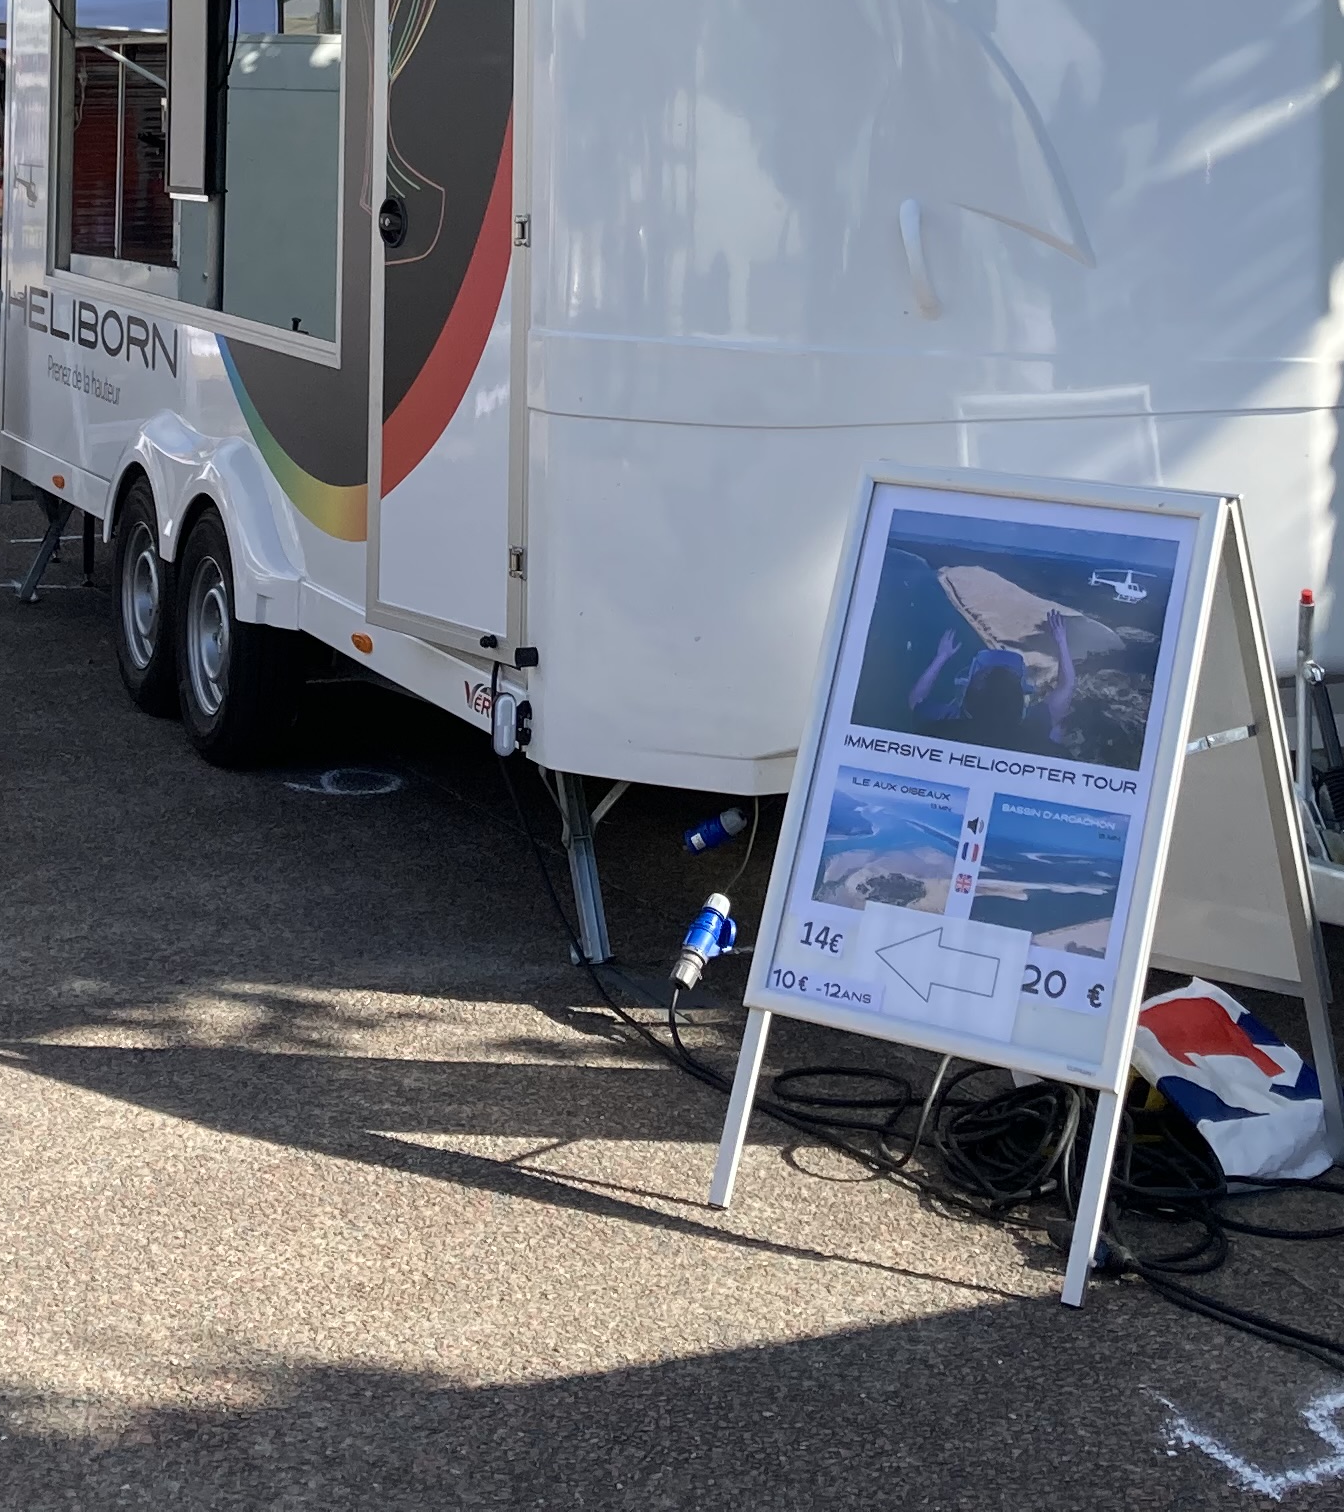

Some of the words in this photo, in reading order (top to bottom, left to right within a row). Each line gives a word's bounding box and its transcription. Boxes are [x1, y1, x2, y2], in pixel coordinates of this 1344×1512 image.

[8, 279, 178, 379] HELIBORN
[48, 354, 71, 387] Prenez
[72, 364, 82, 391] de
[83, 364, 90, 394] la
[91, 369, 121, 406] hauteur
[843, 734, 944, 763] IMMERSIVE
[948, 752, 1076, 786] HELICOPTER
[1082, 774, 1138, 795] TOUR
[852, 776, 871, 787] ILE
[873, 780, 897, 792] AUX
[900, 785, 951, 801] OISEAUX
[1001, 803, 1041, 818] BASSIN
[1042, 810, 1116, 831] D'ARCACHON
[800, 921, 844, 954] 14€
[1020, 964, 1067, 999] 20
